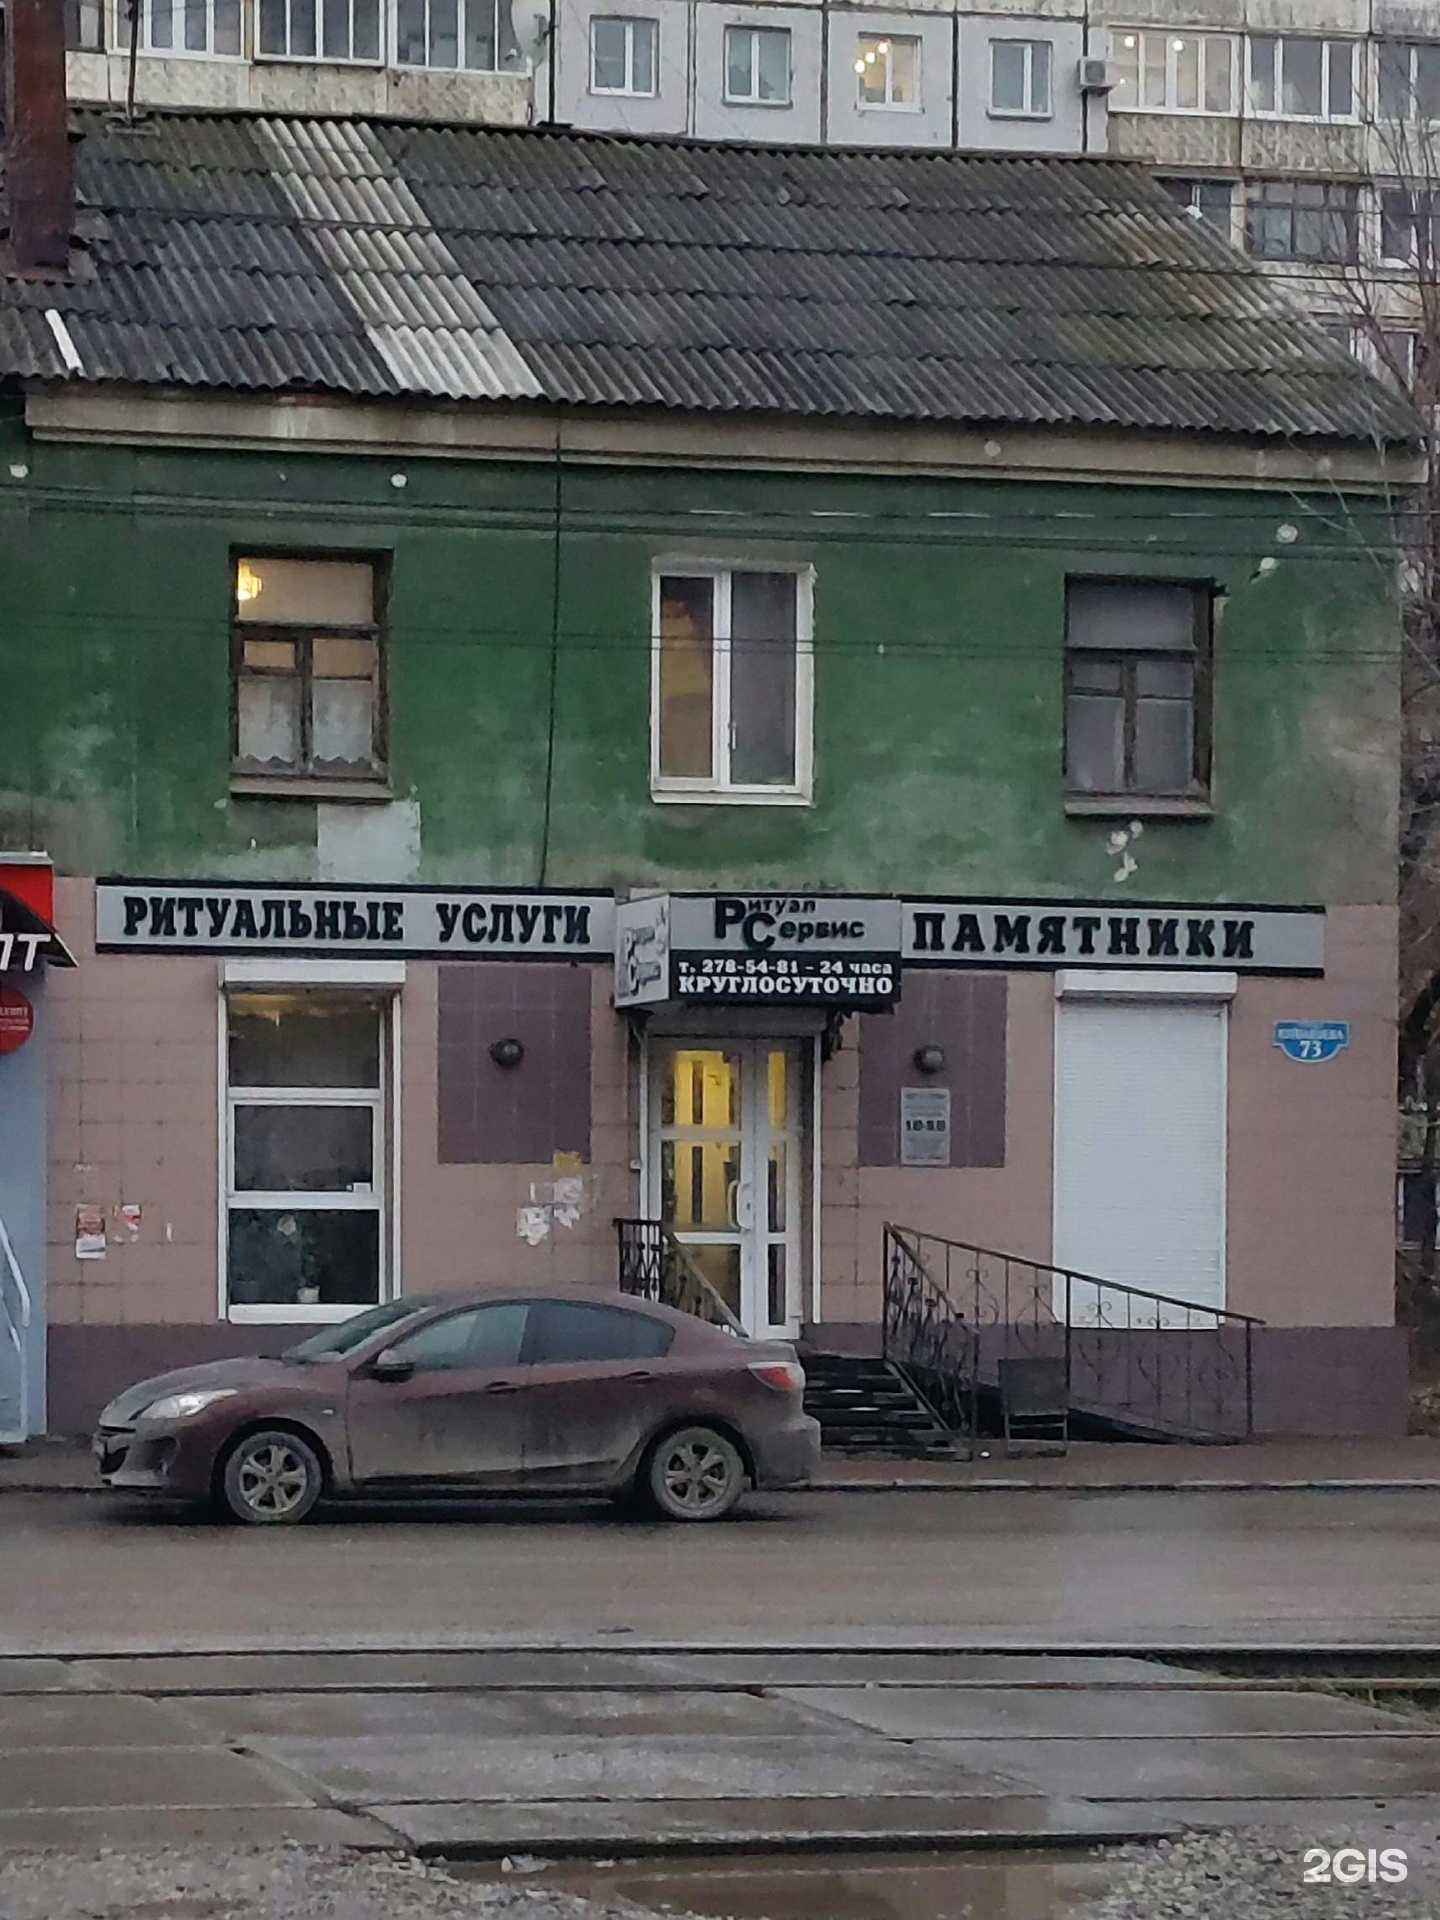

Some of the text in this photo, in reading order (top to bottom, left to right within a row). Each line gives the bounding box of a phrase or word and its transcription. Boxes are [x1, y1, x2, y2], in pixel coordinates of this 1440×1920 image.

[123, 896, 592, 944] РИТУАЛЬНЫЕ УСЛУГИ
[742, 912, 865, 950] Сервис
[912, 912, 1256, 959] ПАМЯТНИКИ
[679, 961, 697, 974] т.
[702, 959, 798, 974] 278-54-81
[820, 961, 844, 974] 24
[850, 961, 893, 975] часа
[678, 976, 894, 994] КРУГЛОСУТОЧНО
[1300, 1040, 1322, 1058] 73
